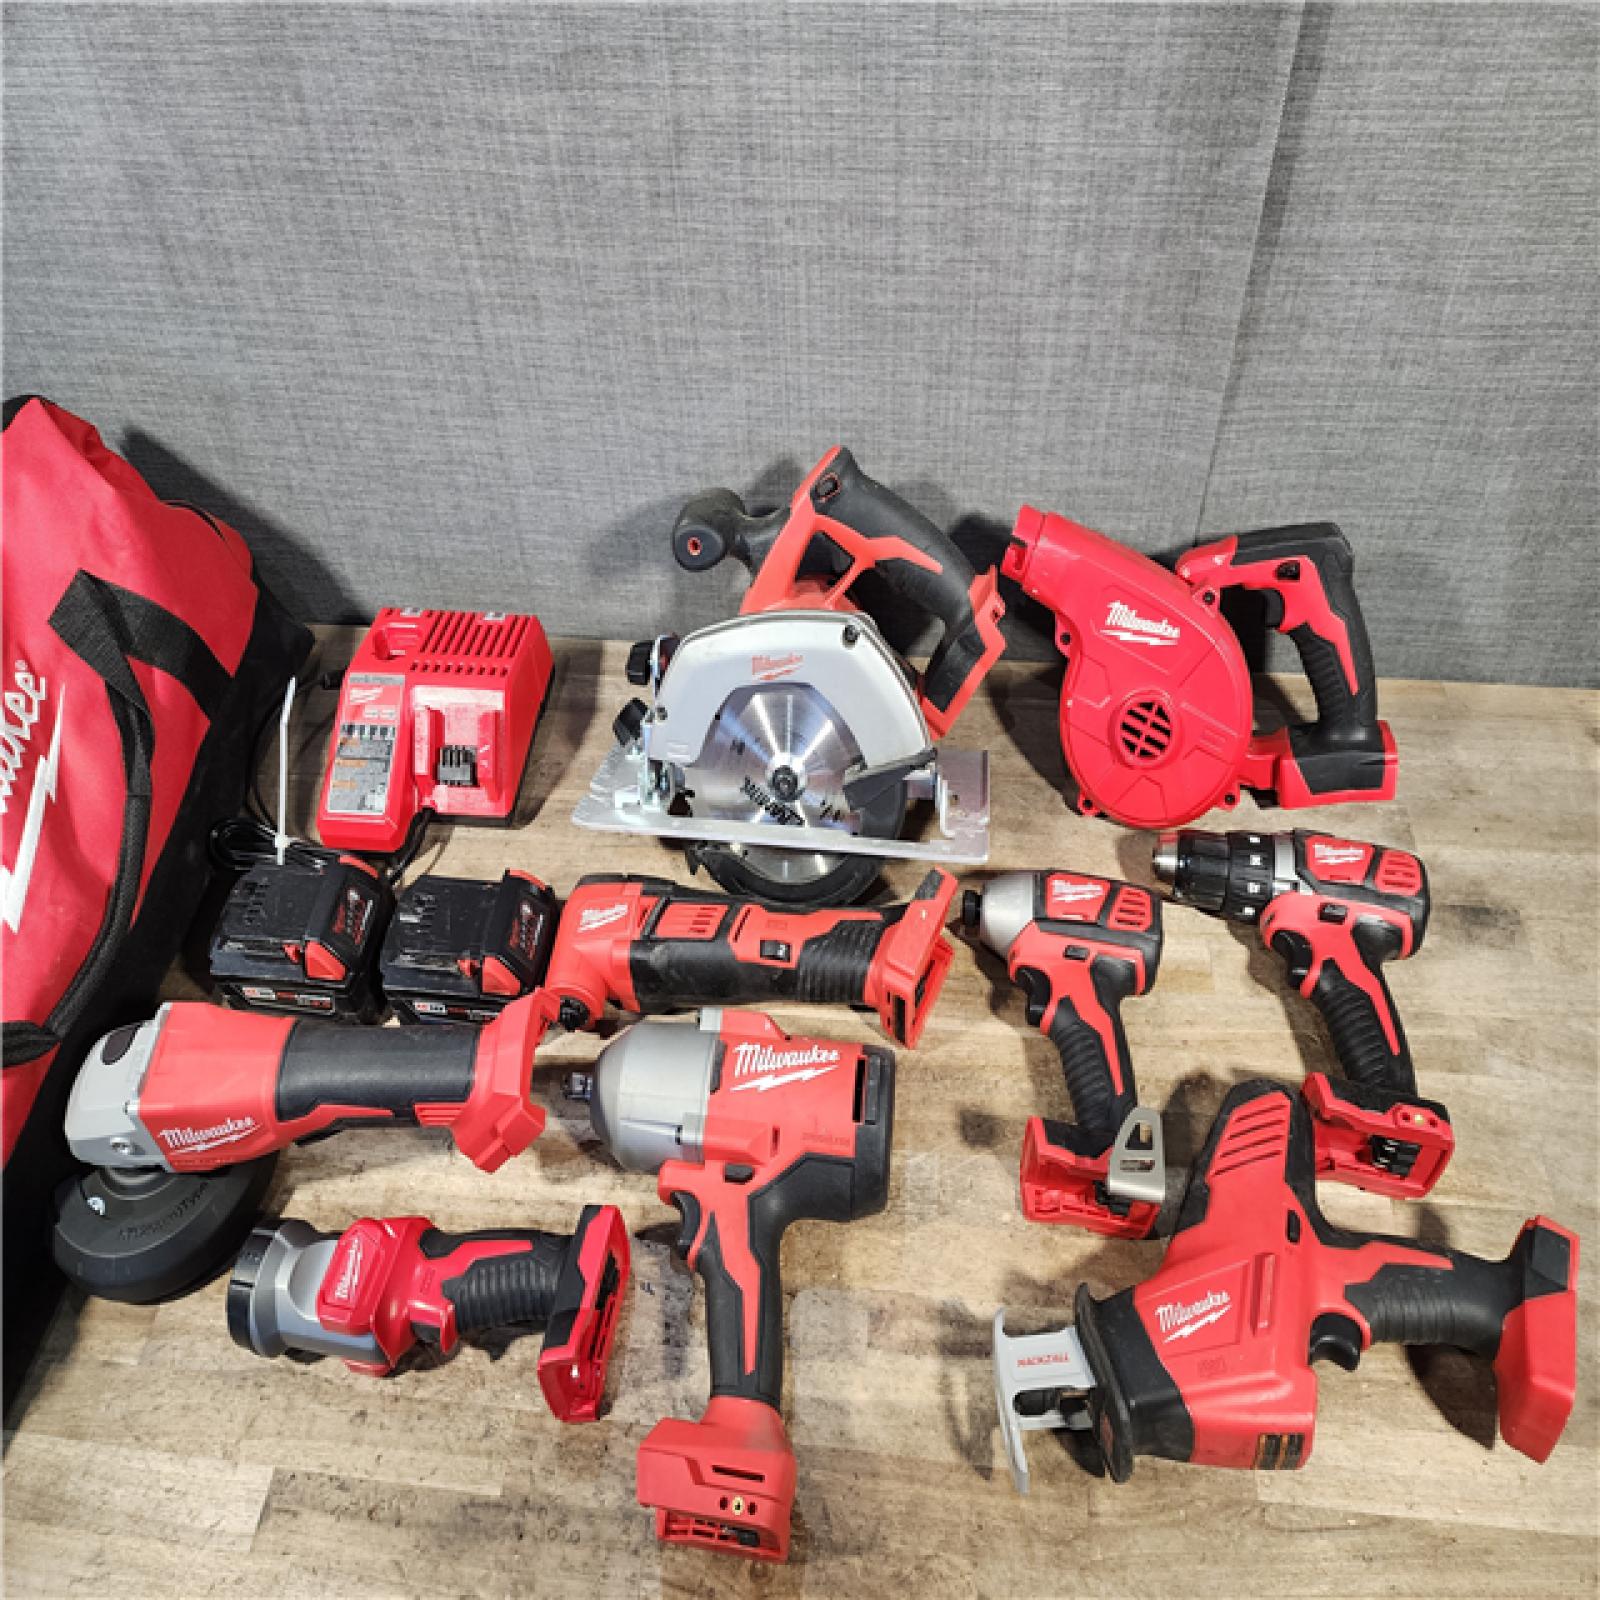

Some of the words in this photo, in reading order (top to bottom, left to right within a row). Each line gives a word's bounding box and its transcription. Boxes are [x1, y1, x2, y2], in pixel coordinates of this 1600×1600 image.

[1105, 600, 1181, 638] Milwaukee
[733, 1042, 841, 1077] Milwaukee
[158, 1116, 256, 1149] Milwaukee
[1155, 1290, 1231, 1333] Milwaukee
